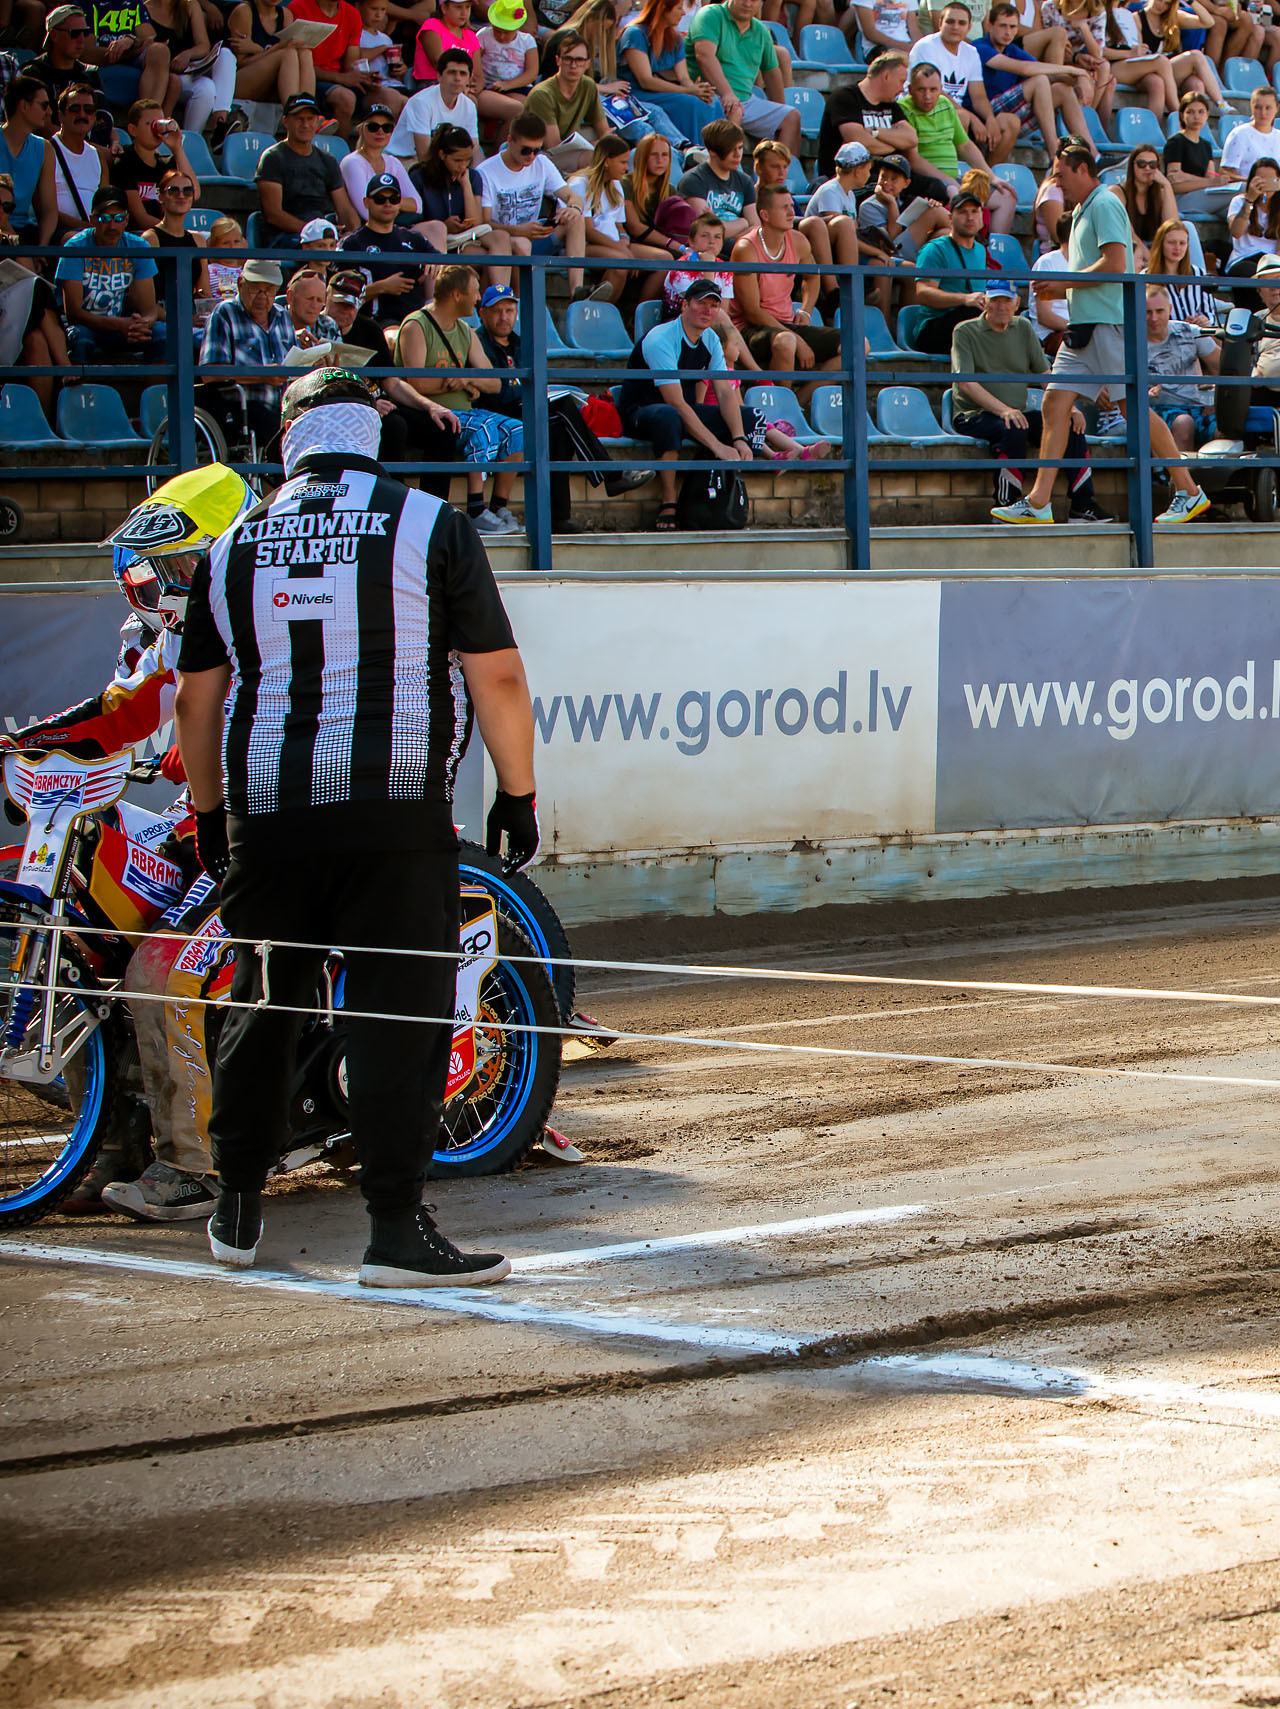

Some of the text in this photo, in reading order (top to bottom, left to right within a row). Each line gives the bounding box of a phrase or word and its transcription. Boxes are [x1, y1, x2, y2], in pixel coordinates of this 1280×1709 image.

[237, 511, 391, 545] KIEROWNIK
[255, 537, 359, 566] STARTU
[291, 593, 334, 605] Nivels
[533, 669, 913, 756] www.gorod.lv
[33, 773, 83, 793] ABRAMCZYK
[131, 846, 186, 892] ABRAMC
